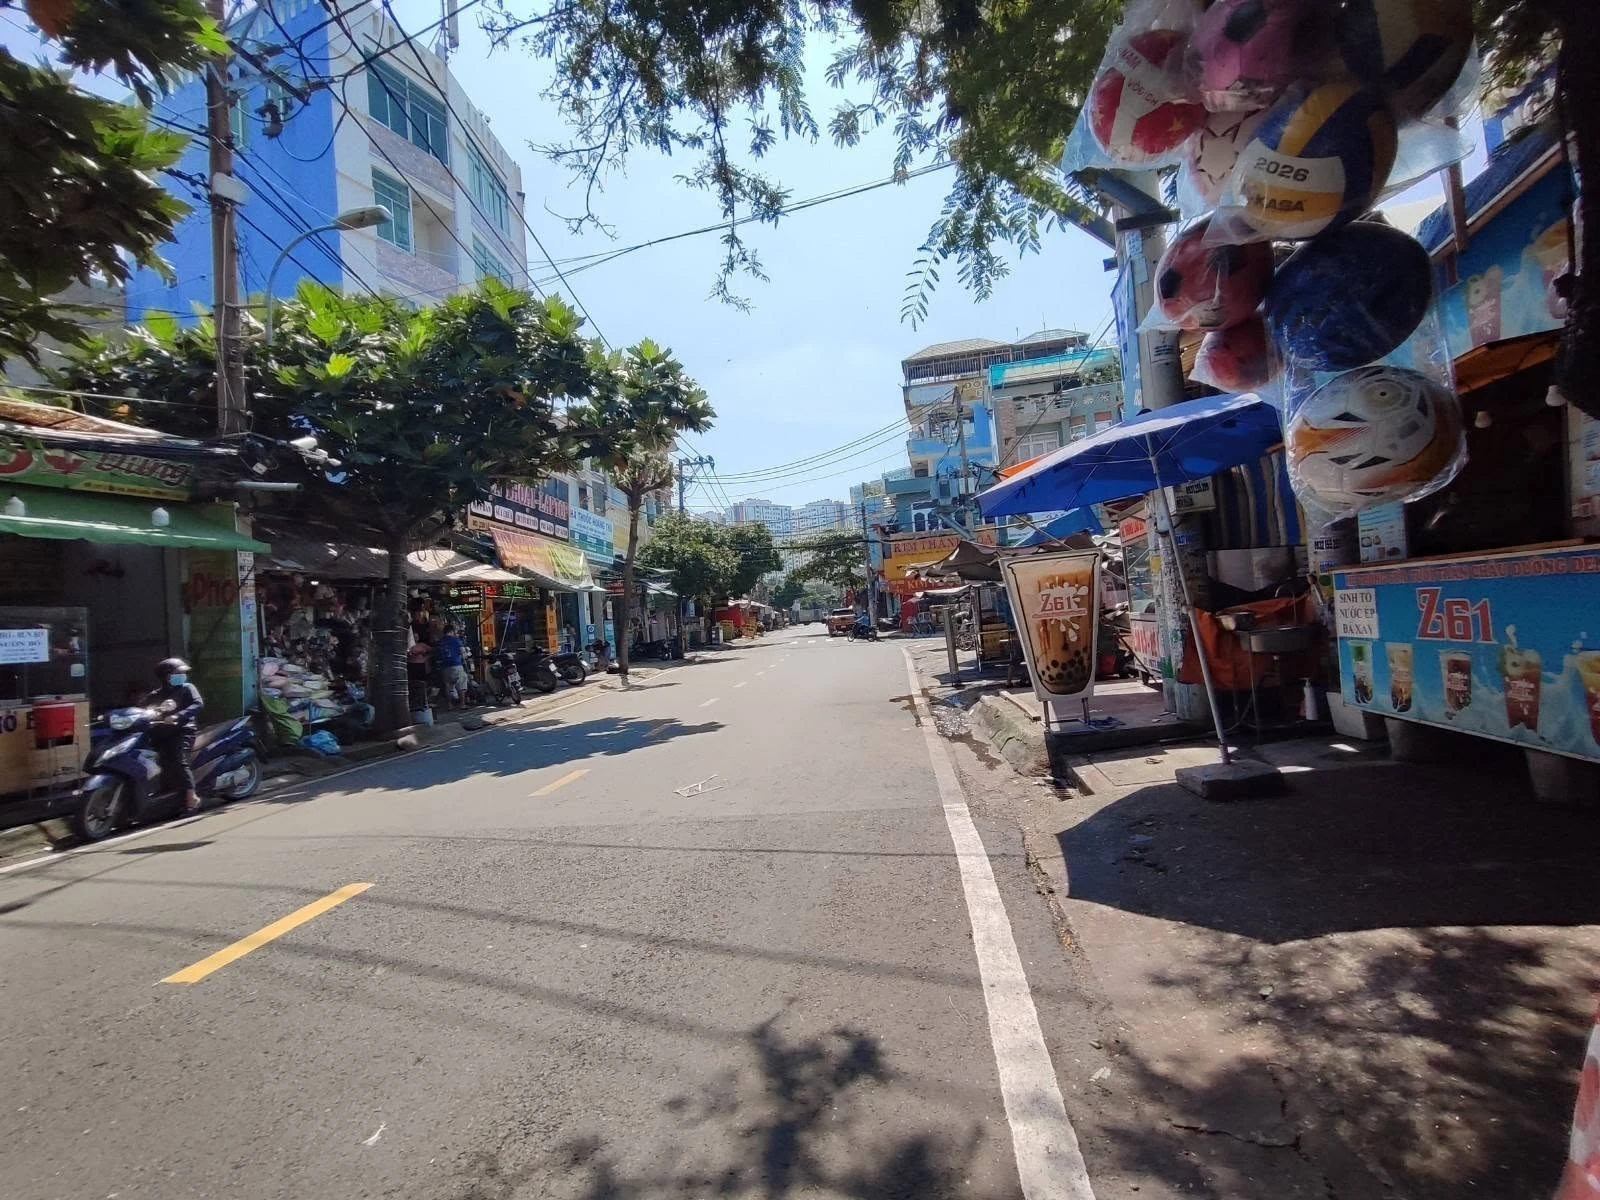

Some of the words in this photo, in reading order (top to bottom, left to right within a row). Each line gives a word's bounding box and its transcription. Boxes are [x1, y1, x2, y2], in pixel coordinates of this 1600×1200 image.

[1254, 157, 1310, 182] 2026
[894, 542, 917, 553] KIM
[1041, 593, 1073, 612] Z61
[1340, 591, 1359, 603] SINH
[1416, 587, 1499, 644] Z61
[1355, 624, 1373, 635] XAY
